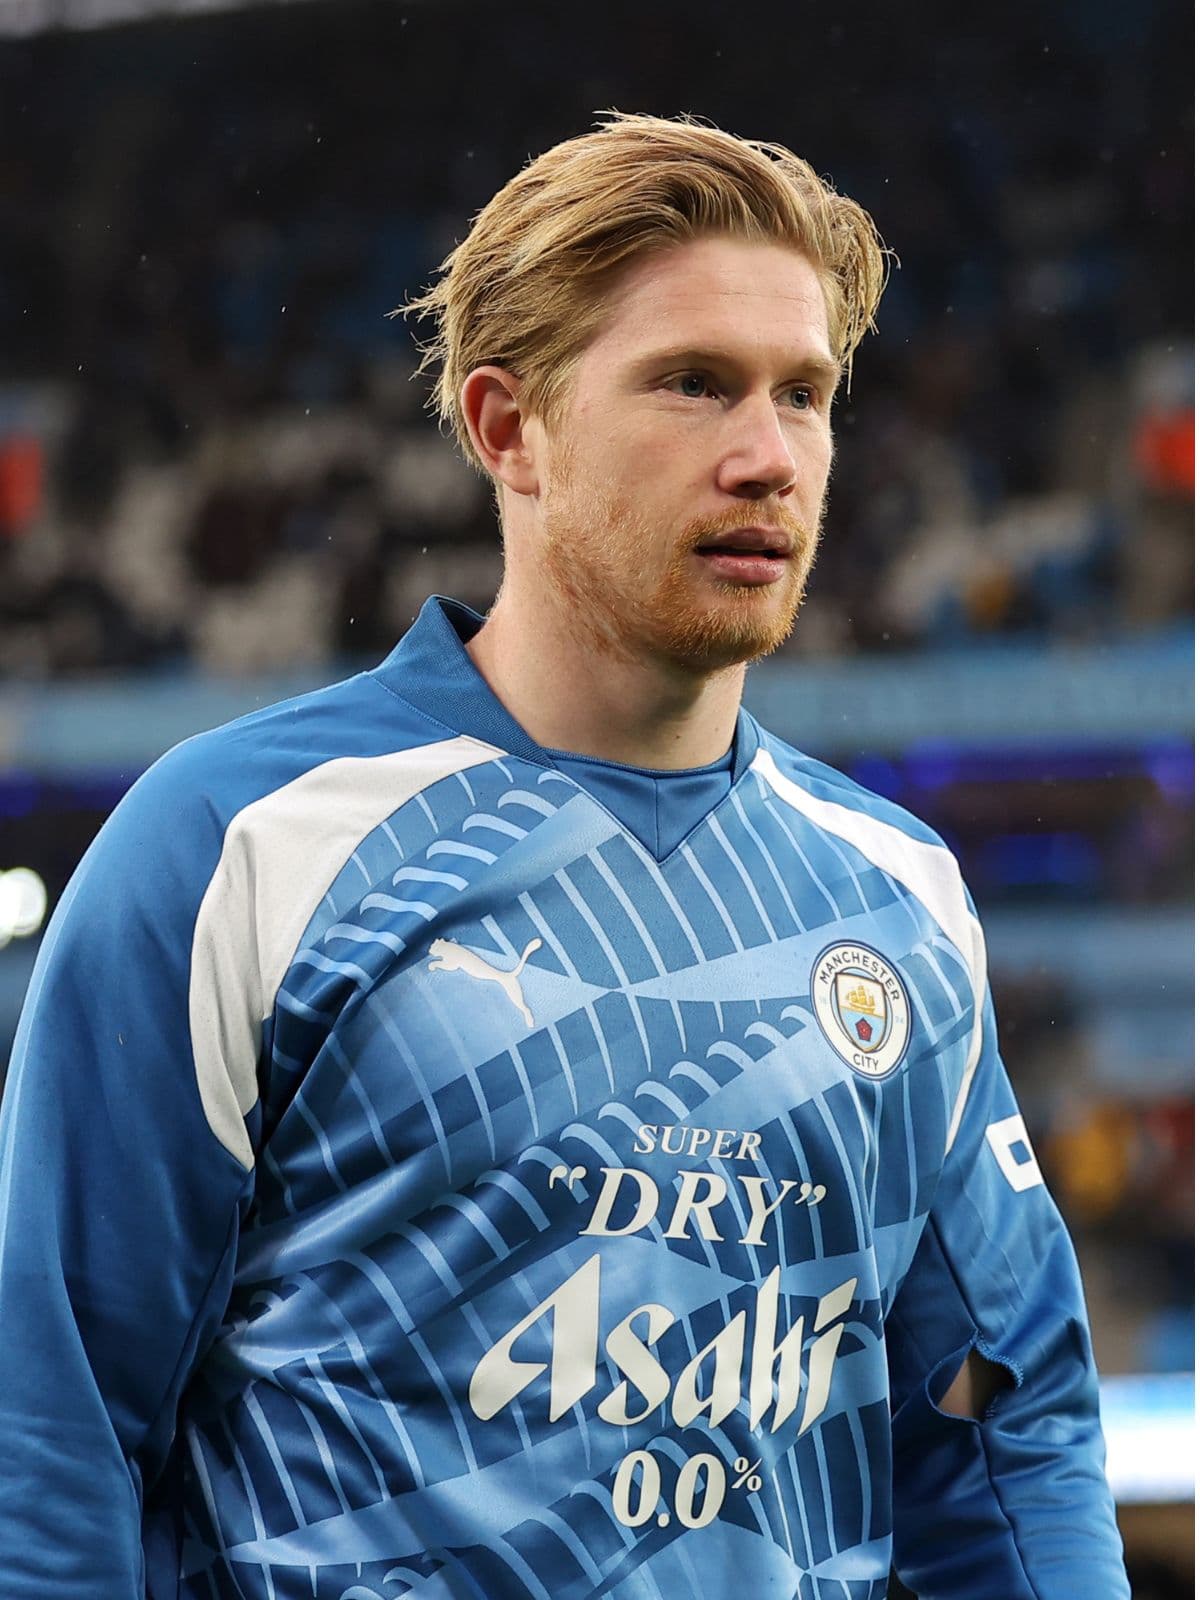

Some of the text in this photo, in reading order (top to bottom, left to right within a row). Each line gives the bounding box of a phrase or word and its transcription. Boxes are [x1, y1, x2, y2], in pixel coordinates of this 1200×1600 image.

[819, 951, 900, 1001] MANCHESTER
[852, 1053, 880, 1072] CITY
[633, 1123, 763, 1162] SUPER
[468, 1252, 858, 1437] Asahi
[610, 1449, 763, 1529] 0.0%
